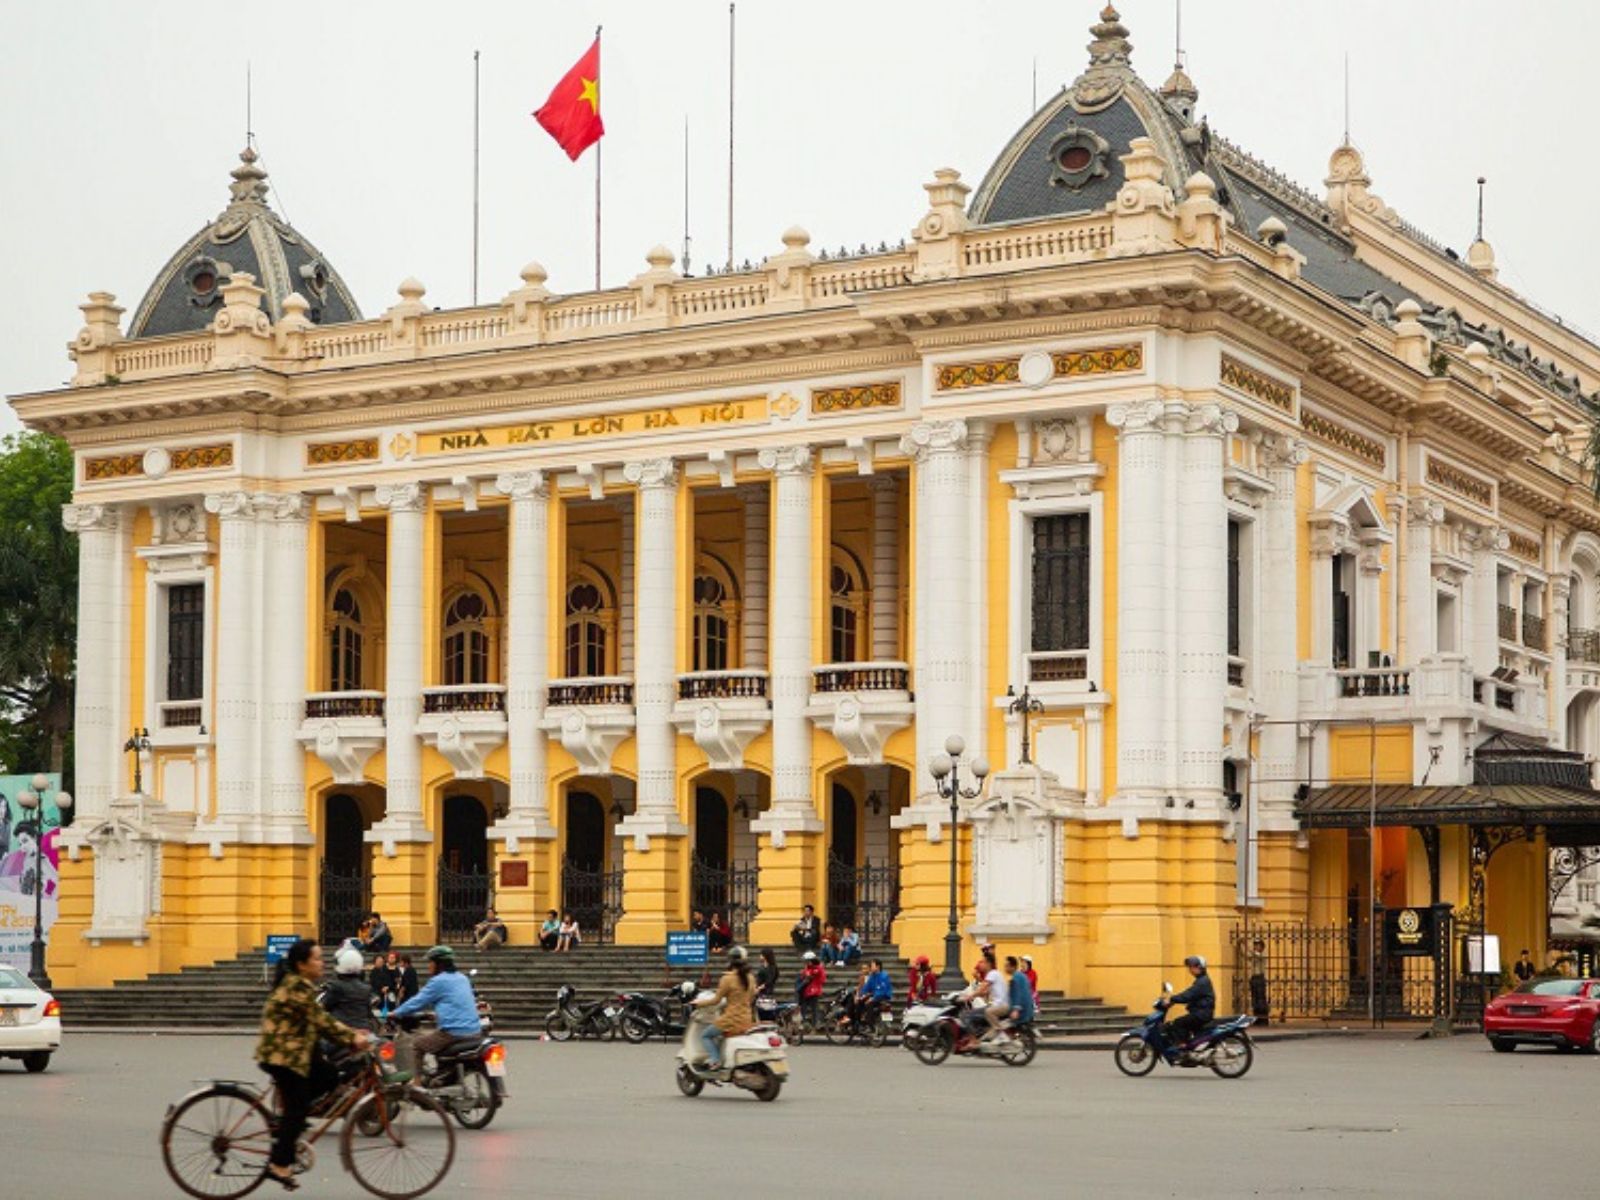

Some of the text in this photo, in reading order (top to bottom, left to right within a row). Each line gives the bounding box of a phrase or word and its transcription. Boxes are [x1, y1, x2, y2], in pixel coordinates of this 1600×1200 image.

[440, 427, 489, 450] NHÀ
[507, 423, 553, 443] HÁT
[644, 408, 679, 429] HÀ
[700, 402, 744, 423] NỘI
